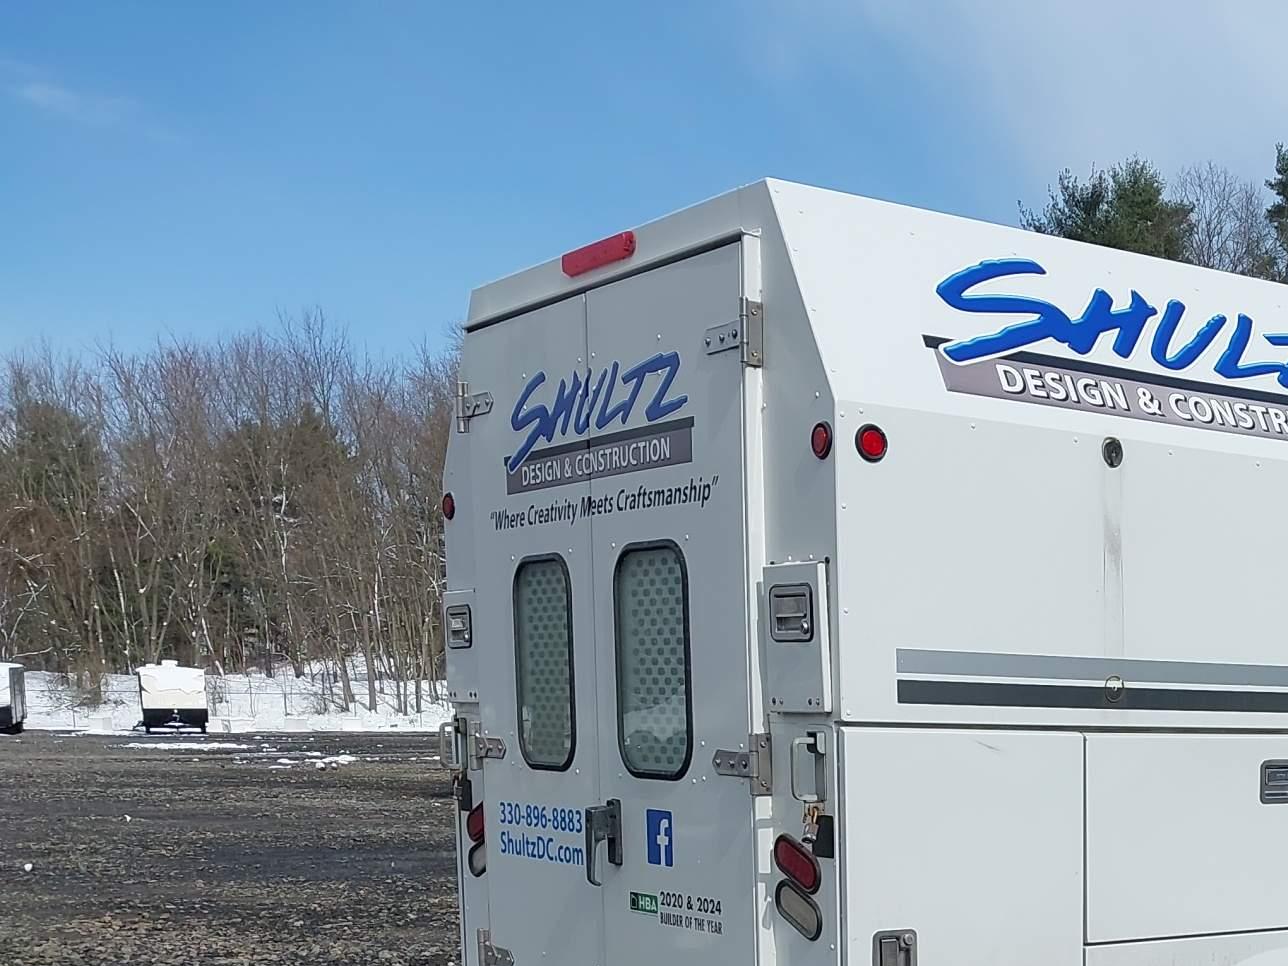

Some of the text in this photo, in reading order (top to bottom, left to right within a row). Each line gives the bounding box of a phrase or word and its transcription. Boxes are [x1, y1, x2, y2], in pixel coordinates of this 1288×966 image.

[995, 363, 1128, 411] DESIGN
[1138, 384, 1164, 415] &
[508, 351, 688, 474] SHULTZ
[521, 437, 670, 486] DESIGN & CONSTRUCTION
[528, 498, 578, 527] Creativity
[580, 494, 613, 518] Meets
[499, 801, 583, 834] 330-896-8883
[500, 831, 585, 866] ShultzDC.com
[638, 895, 657, 911] HBA
[660, 891, 722, 915] 2020 & 2024
[660, 912, 723, 935] BUILDER OF THE YEAR
